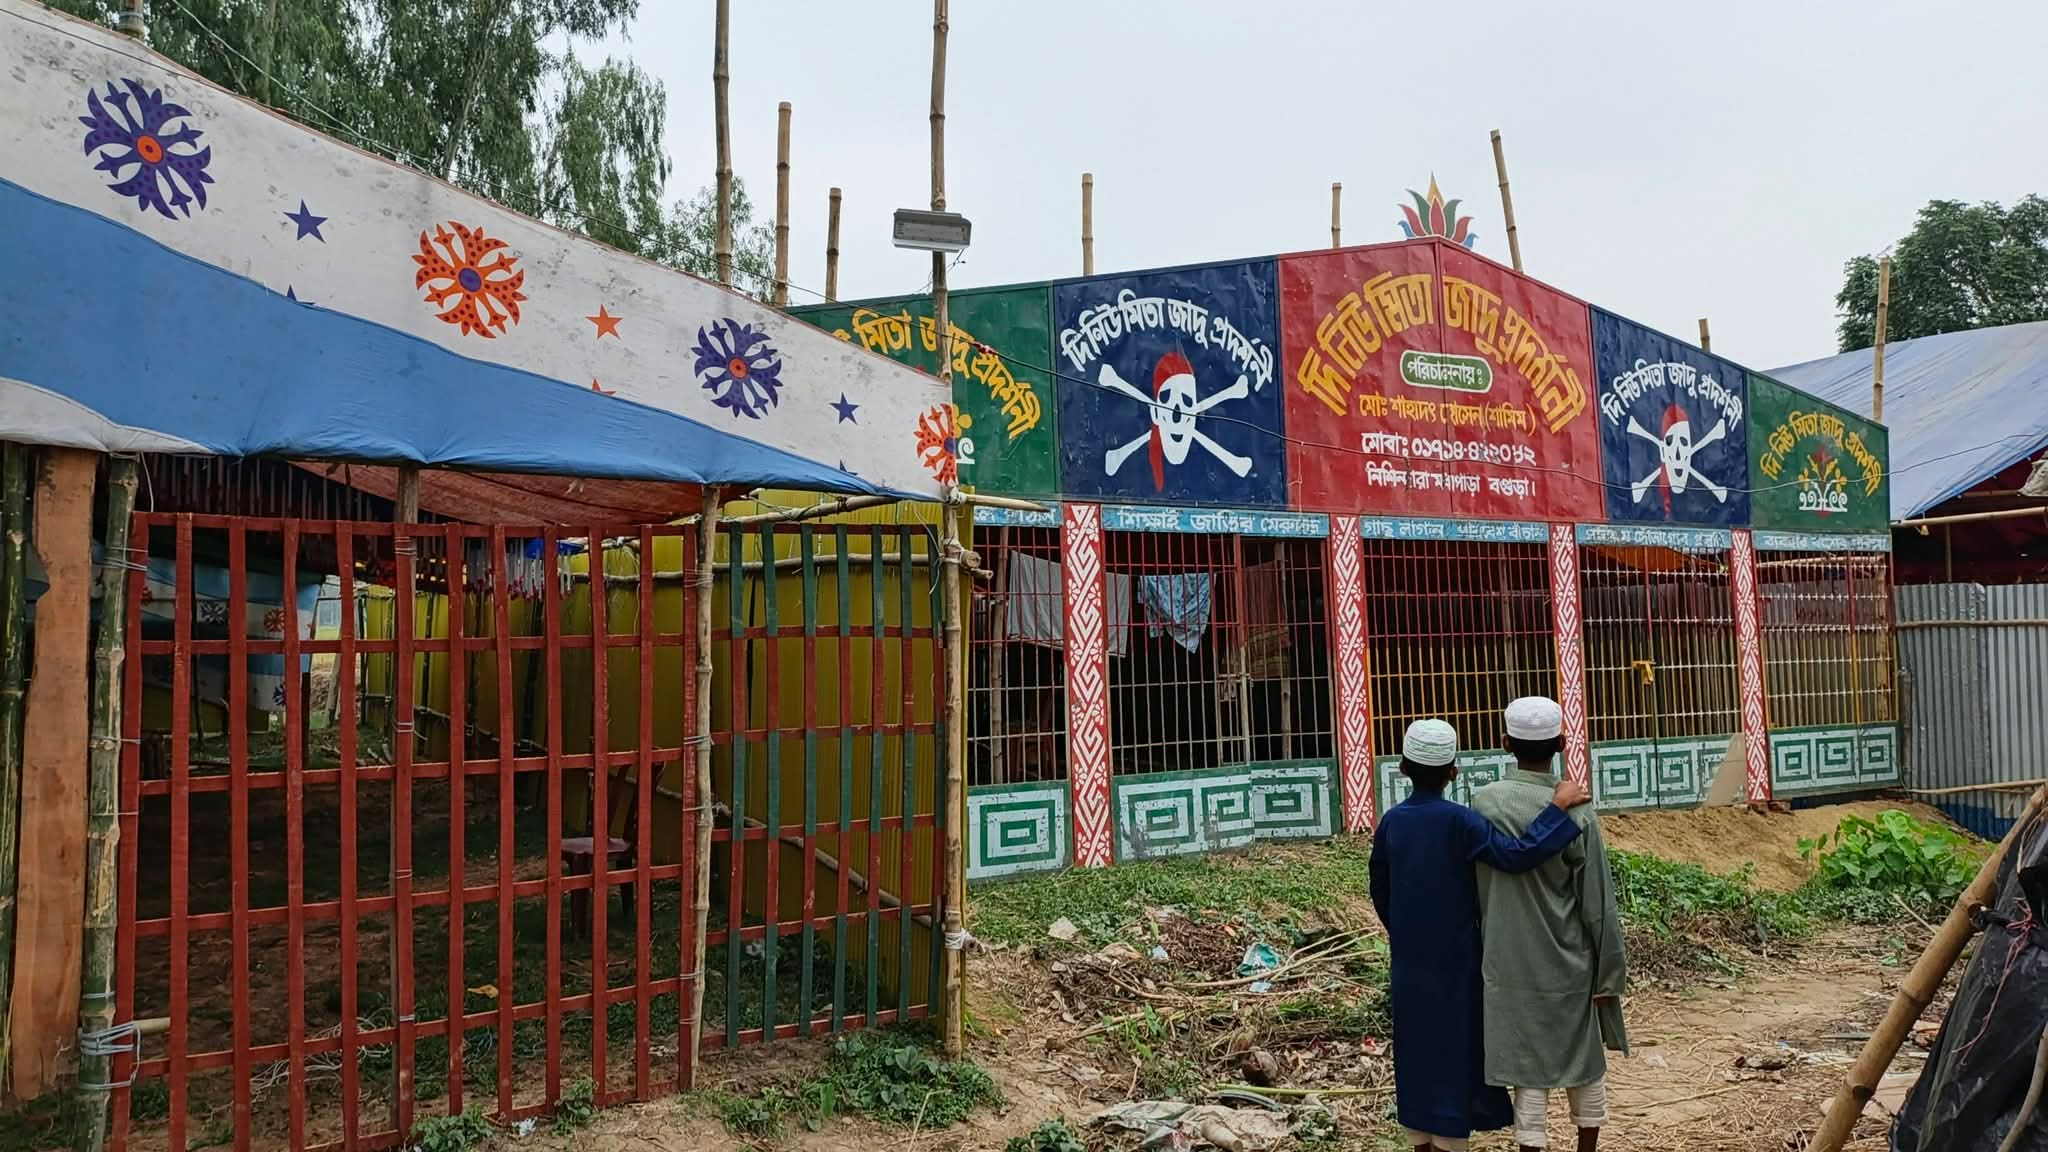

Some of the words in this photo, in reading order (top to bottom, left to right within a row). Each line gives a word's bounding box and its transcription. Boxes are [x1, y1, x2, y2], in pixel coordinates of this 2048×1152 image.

[1167, 298, 1209, 349] জাদু
[1210, 316, 1273, 392] প্রদর্শনী
[1363, 271, 1433, 339] মিতা
[1442, 275, 1503, 355] জাদু
[1499, 307, 1586, 434] প্রদর্শনী
[1666, 361, 1698, 399] জাদু
[1698, 373, 1743, 432] প্রদর্শনী
[1789, 410, 1818, 442] মিতা
